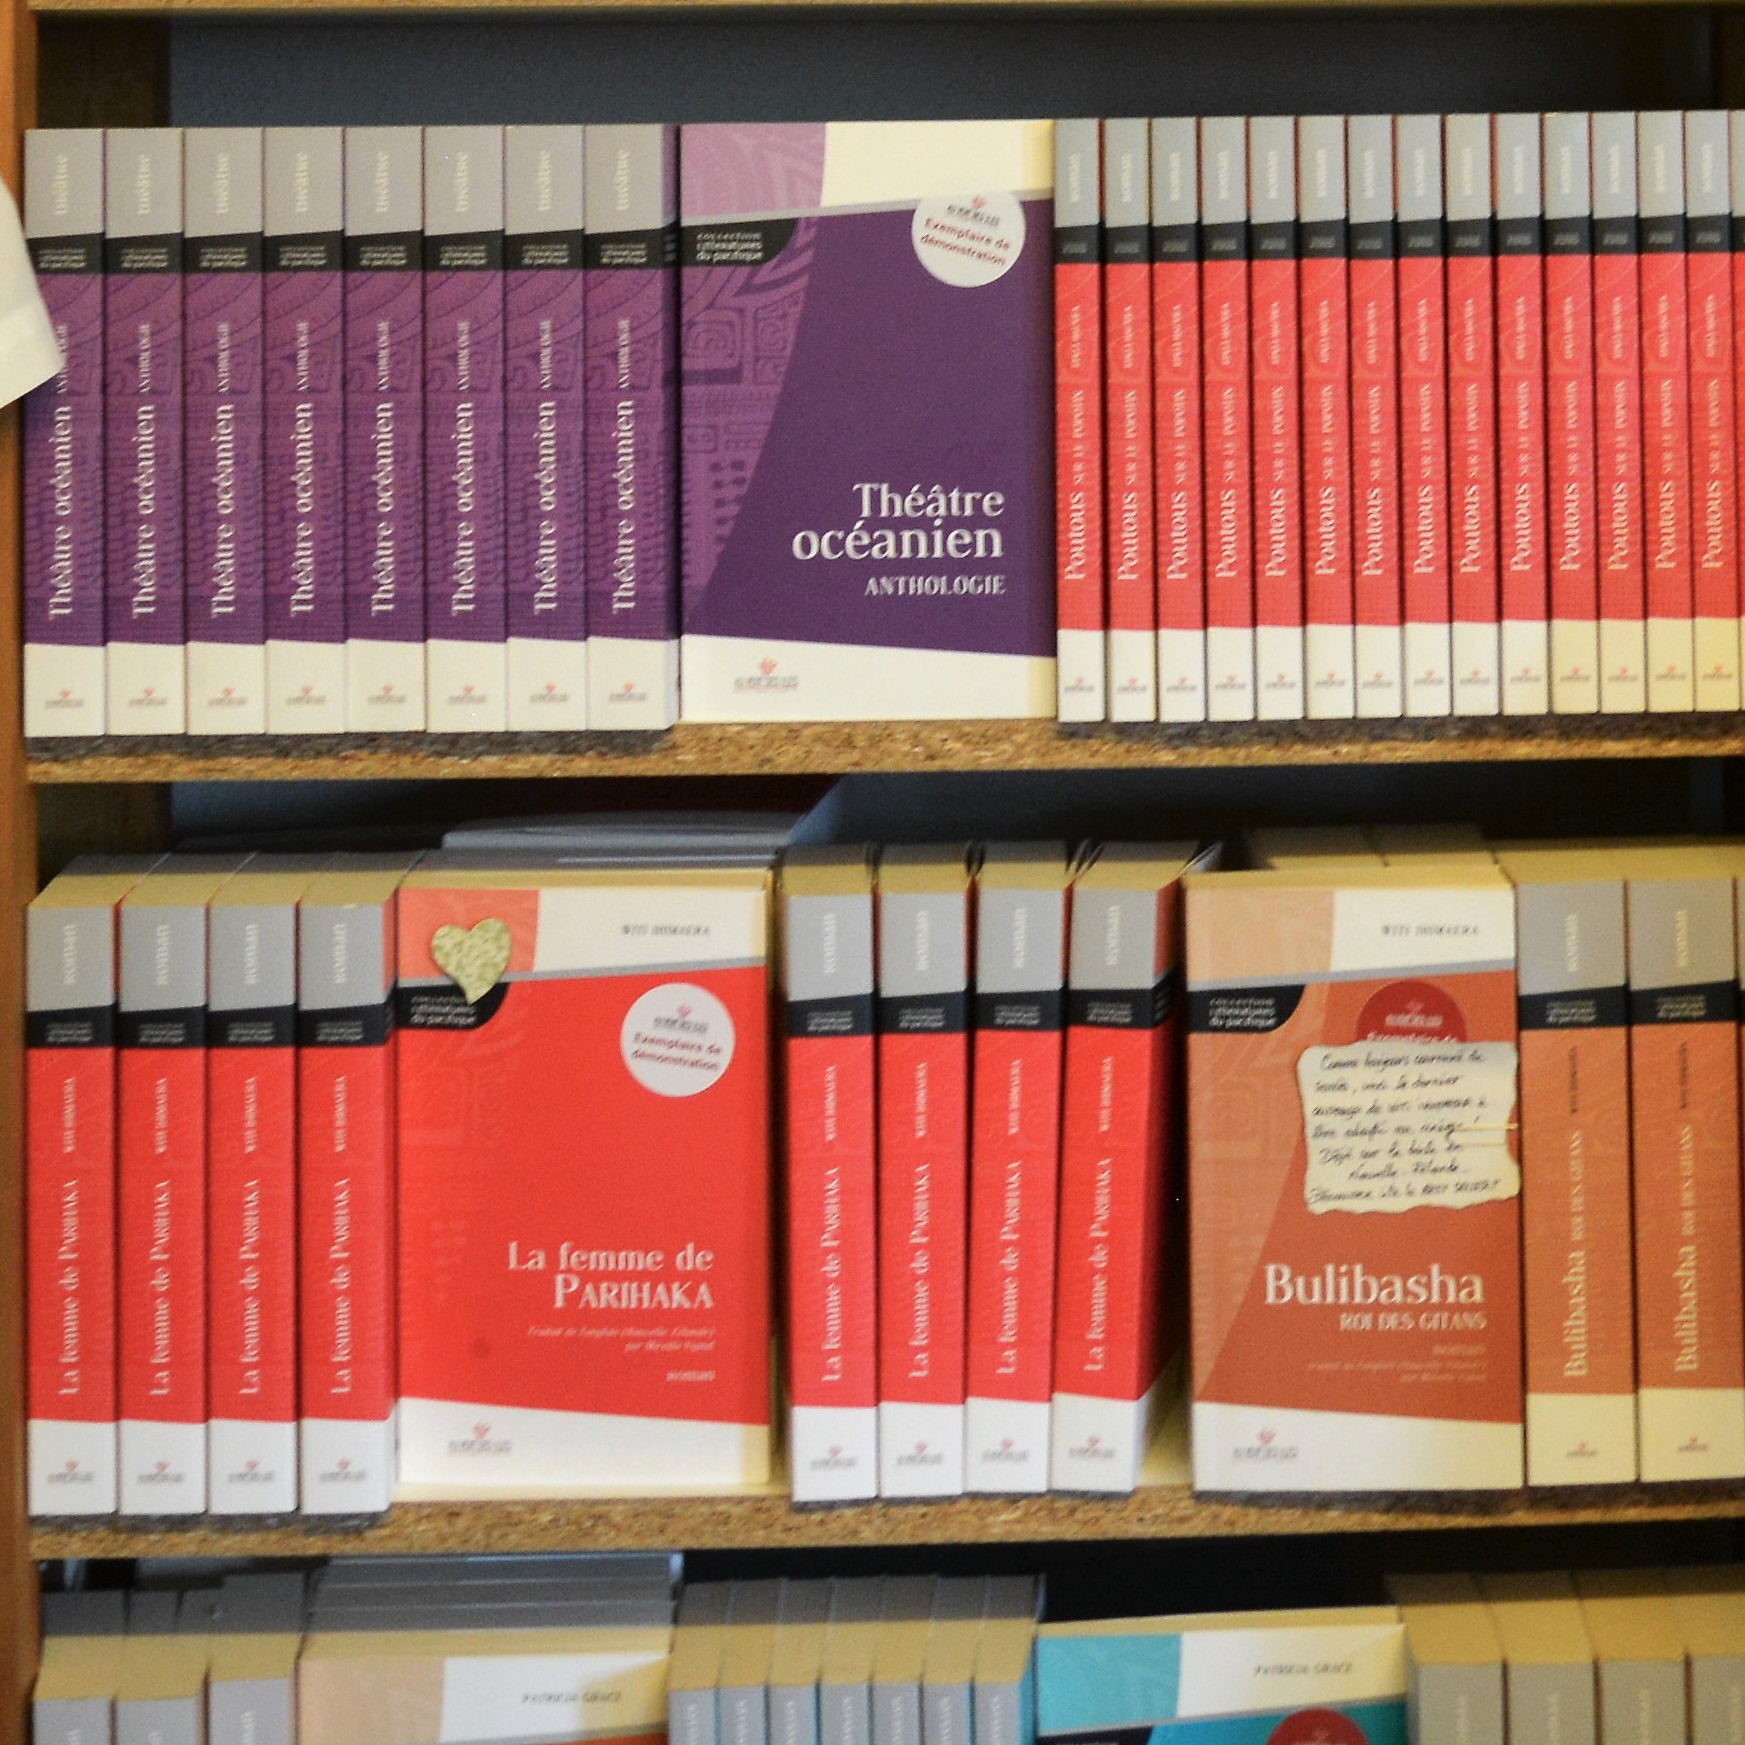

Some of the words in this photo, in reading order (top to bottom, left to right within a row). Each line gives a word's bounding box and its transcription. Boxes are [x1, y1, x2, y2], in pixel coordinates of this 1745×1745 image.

[924, 217, 992, 247] Exemplaire
[132, 404, 156, 514] océanien
[853, 482, 1005, 517] Théâtre
[792, 518, 1004, 560] océanien
[1459, 484, 1481, 573] Poutous
[131, 523, 156, 617] Théâtre
[864, 575, 1006, 596] ANTHOLOGIE
[508, 1240, 546, 1271] La
[559, 1241, 665, 1272] femme
[675, 1242, 715, 1271] de
[57, 1266, 78, 1290] de
[553, 1273, 715, 1309] PARIHAKA
[1264, 1262, 1485, 1305] Bulibasha
[58, 1296, 79, 1362] femme
[1339, 1312, 1373, 1331] ROI
[1378, 1312, 1415, 1331] DES
[1419, 1311, 1487, 1331] GITANS
[1562, 1249, 1587, 1377] Bulibasha
[57, 1370, 79, 1394] La
